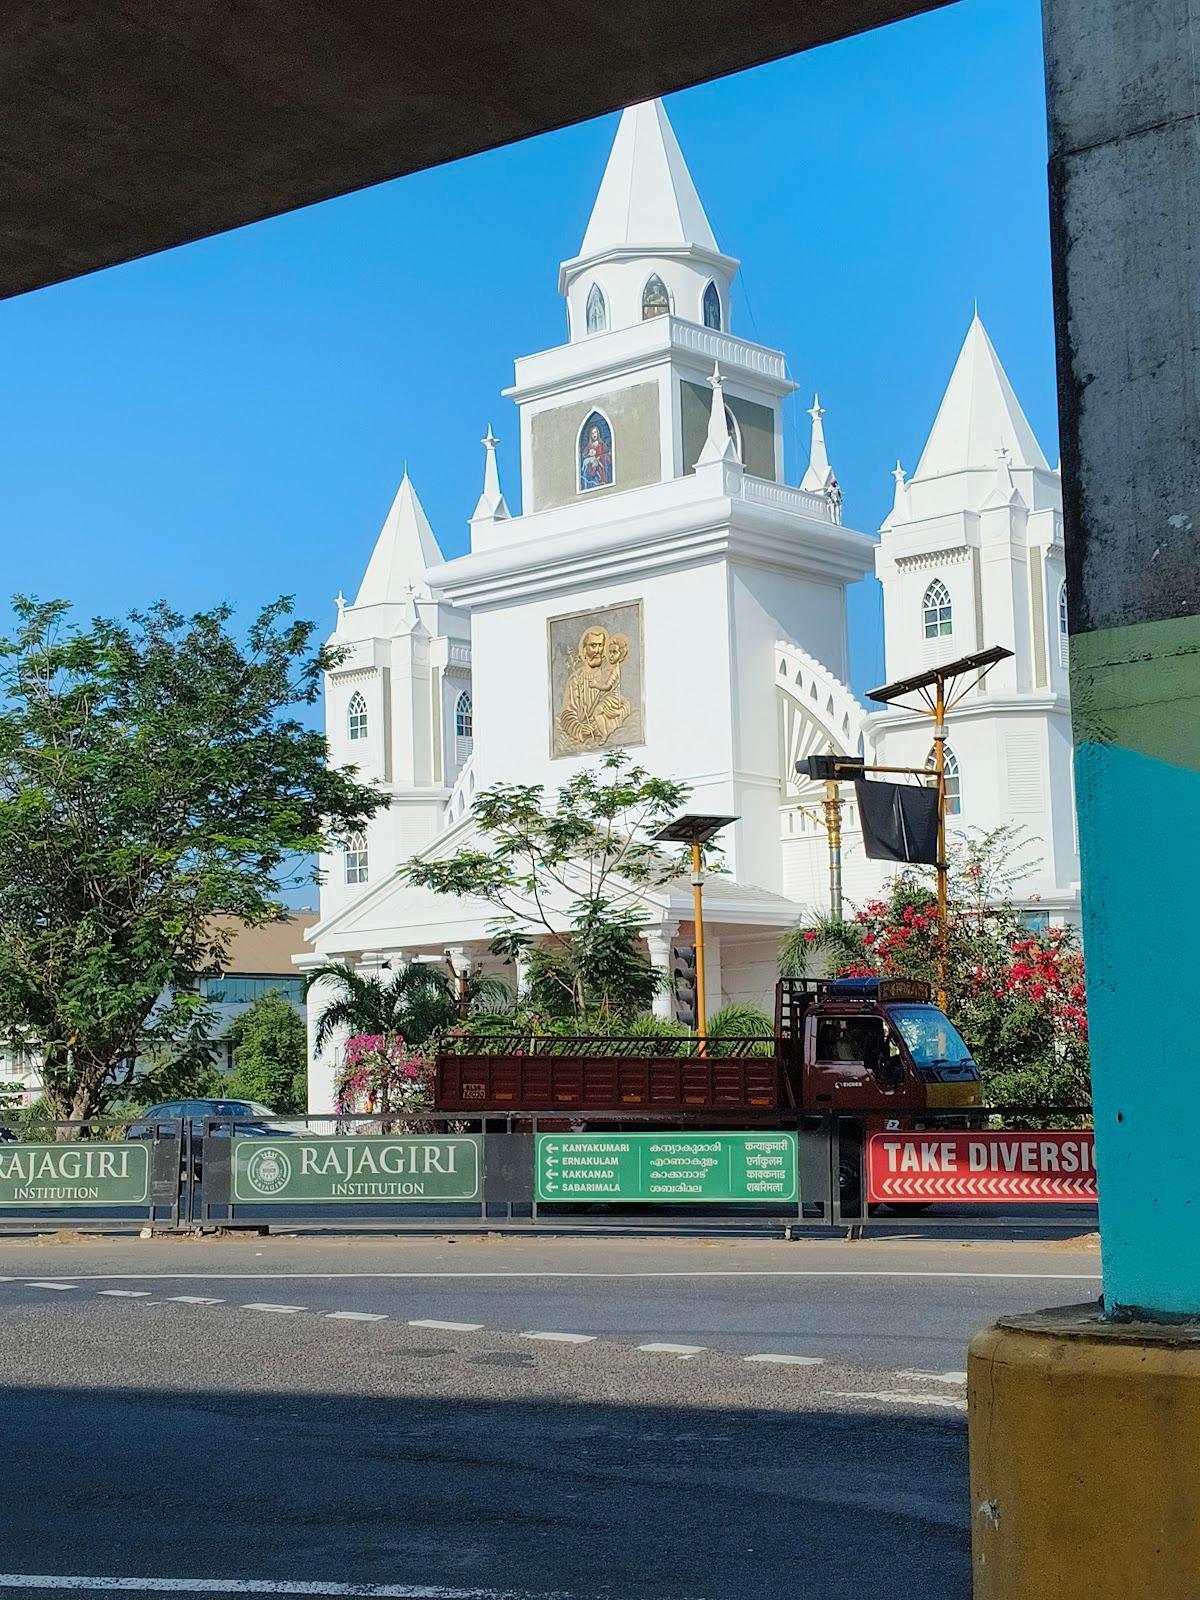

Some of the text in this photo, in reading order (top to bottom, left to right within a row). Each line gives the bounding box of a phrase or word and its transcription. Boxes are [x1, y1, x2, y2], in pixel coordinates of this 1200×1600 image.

[562, 1144, 630, 1152] KANYAKUMARI
[650, 1141, 721, 1154] കന്യാകുമാരി
[562, 1157, 619, 1166] ERNAKULAM
[884, 1142, 1097, 1172] TAKE DIVERSI
[299, 1146, 457, 1182] RAJAGIRI
[650, 1158, 718, 1167] എറണാകുളം
[562, 1170, 614, 1178] KAKKANAD
[650, 1169, 708, 1178] കാക്കനാട്
[332, 1183, 424, 1195] INSTITUTION
[562, 1183, 621, 1192] SABARIMALA
[650, 1182, 702, 1192] ശബരിമല
[14, 1187, 99, 1199] INSTITUTION
